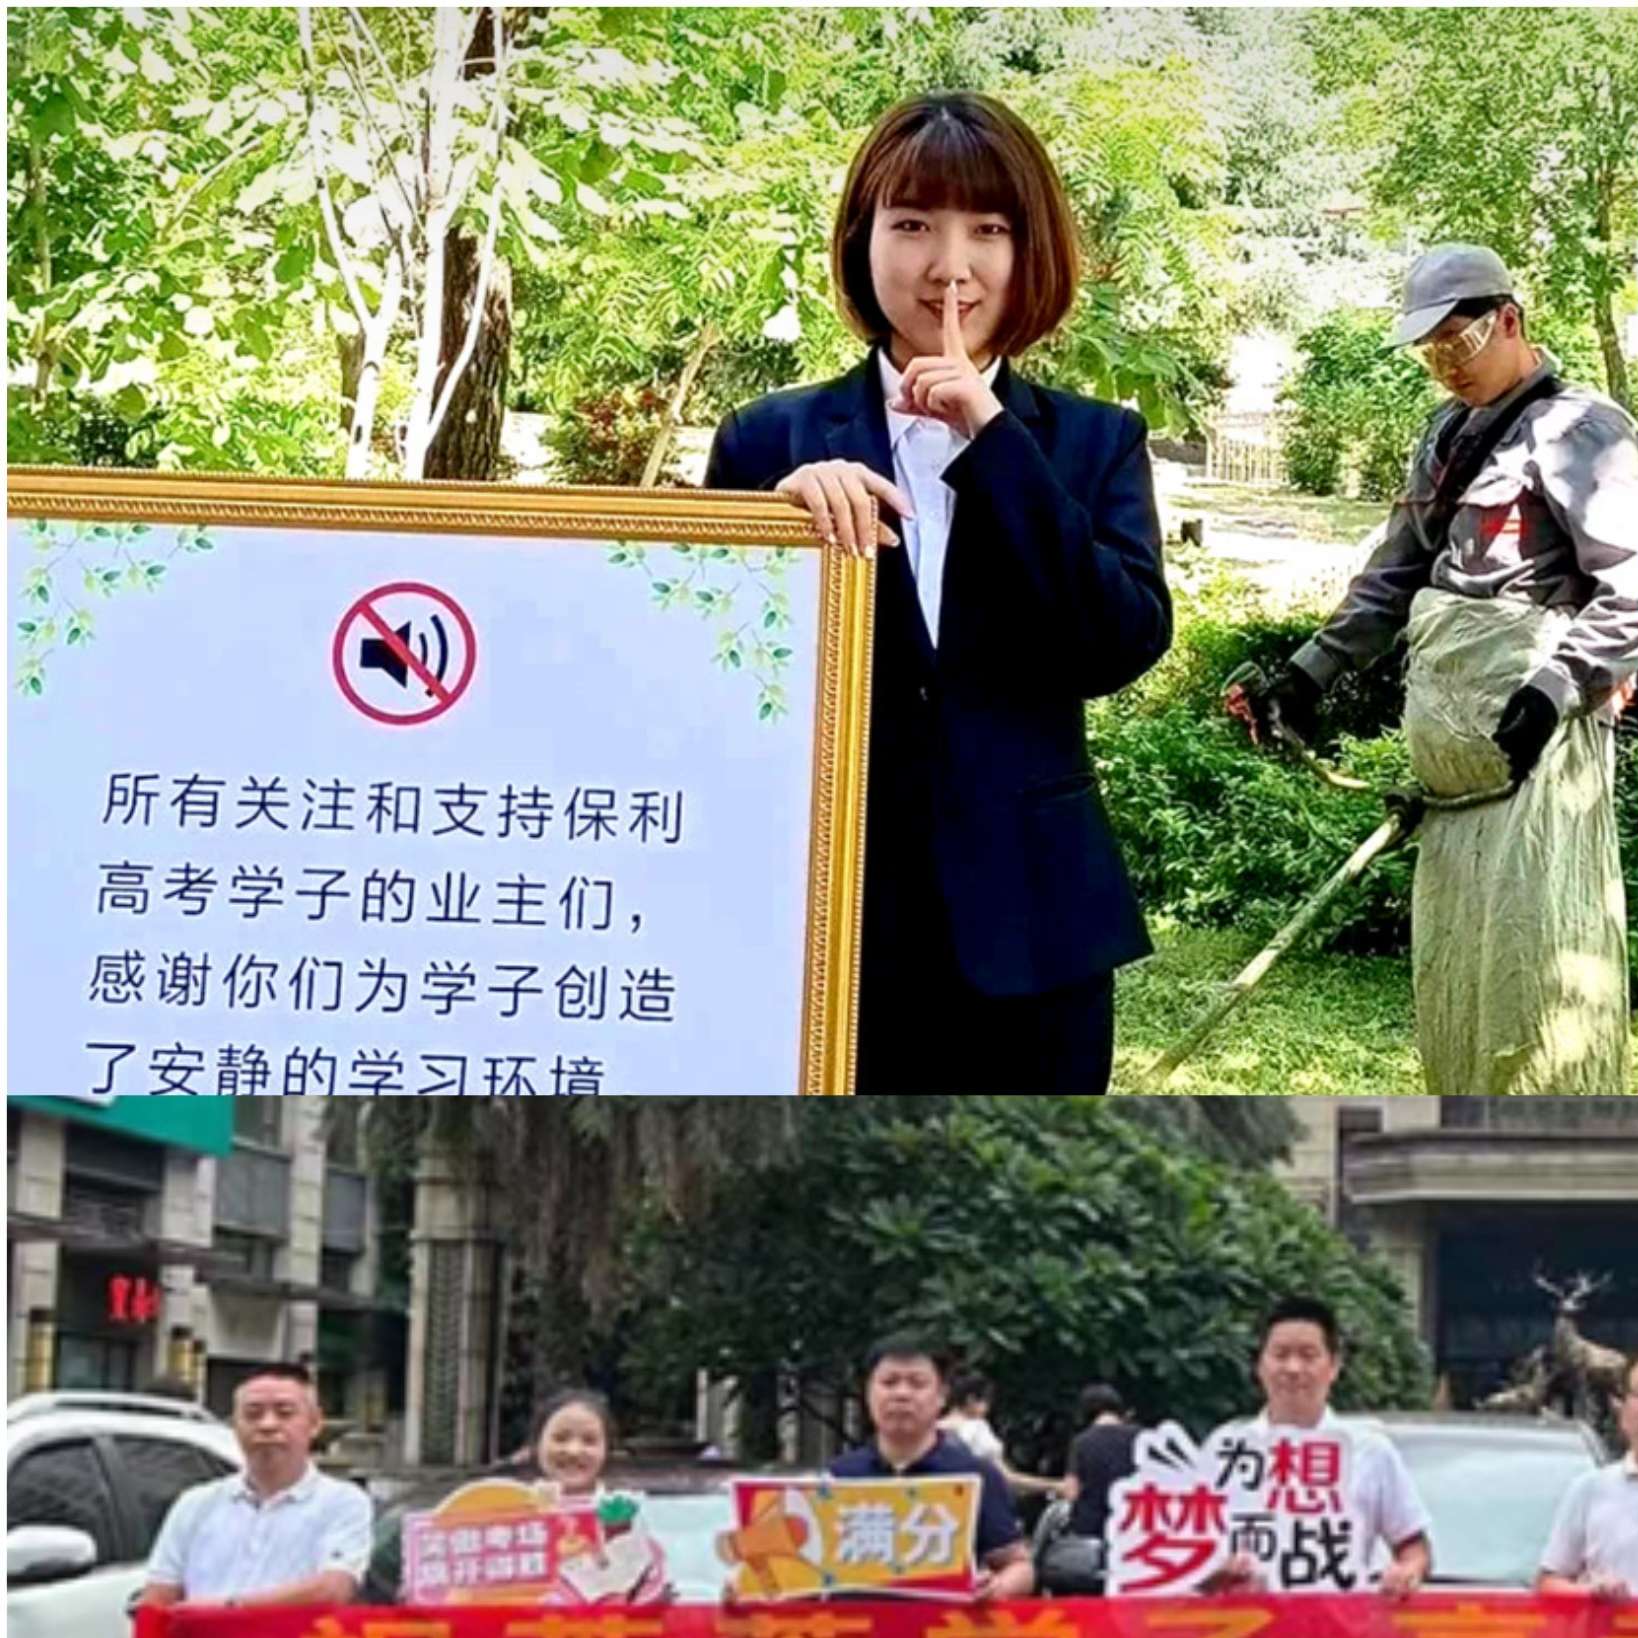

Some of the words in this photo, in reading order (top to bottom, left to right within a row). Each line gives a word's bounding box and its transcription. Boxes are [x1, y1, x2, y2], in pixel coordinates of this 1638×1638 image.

[102, 772, 685, 845] 所有关注和支持保利
[96, 860, 646, 937] 高考学子的业主们，
[88, 951, 678, 1025] 感谢你们为学子创造
[82, 1039, 606, 1096] 了安静的学习环境
[834, 1503, 960, 1566] 满分
